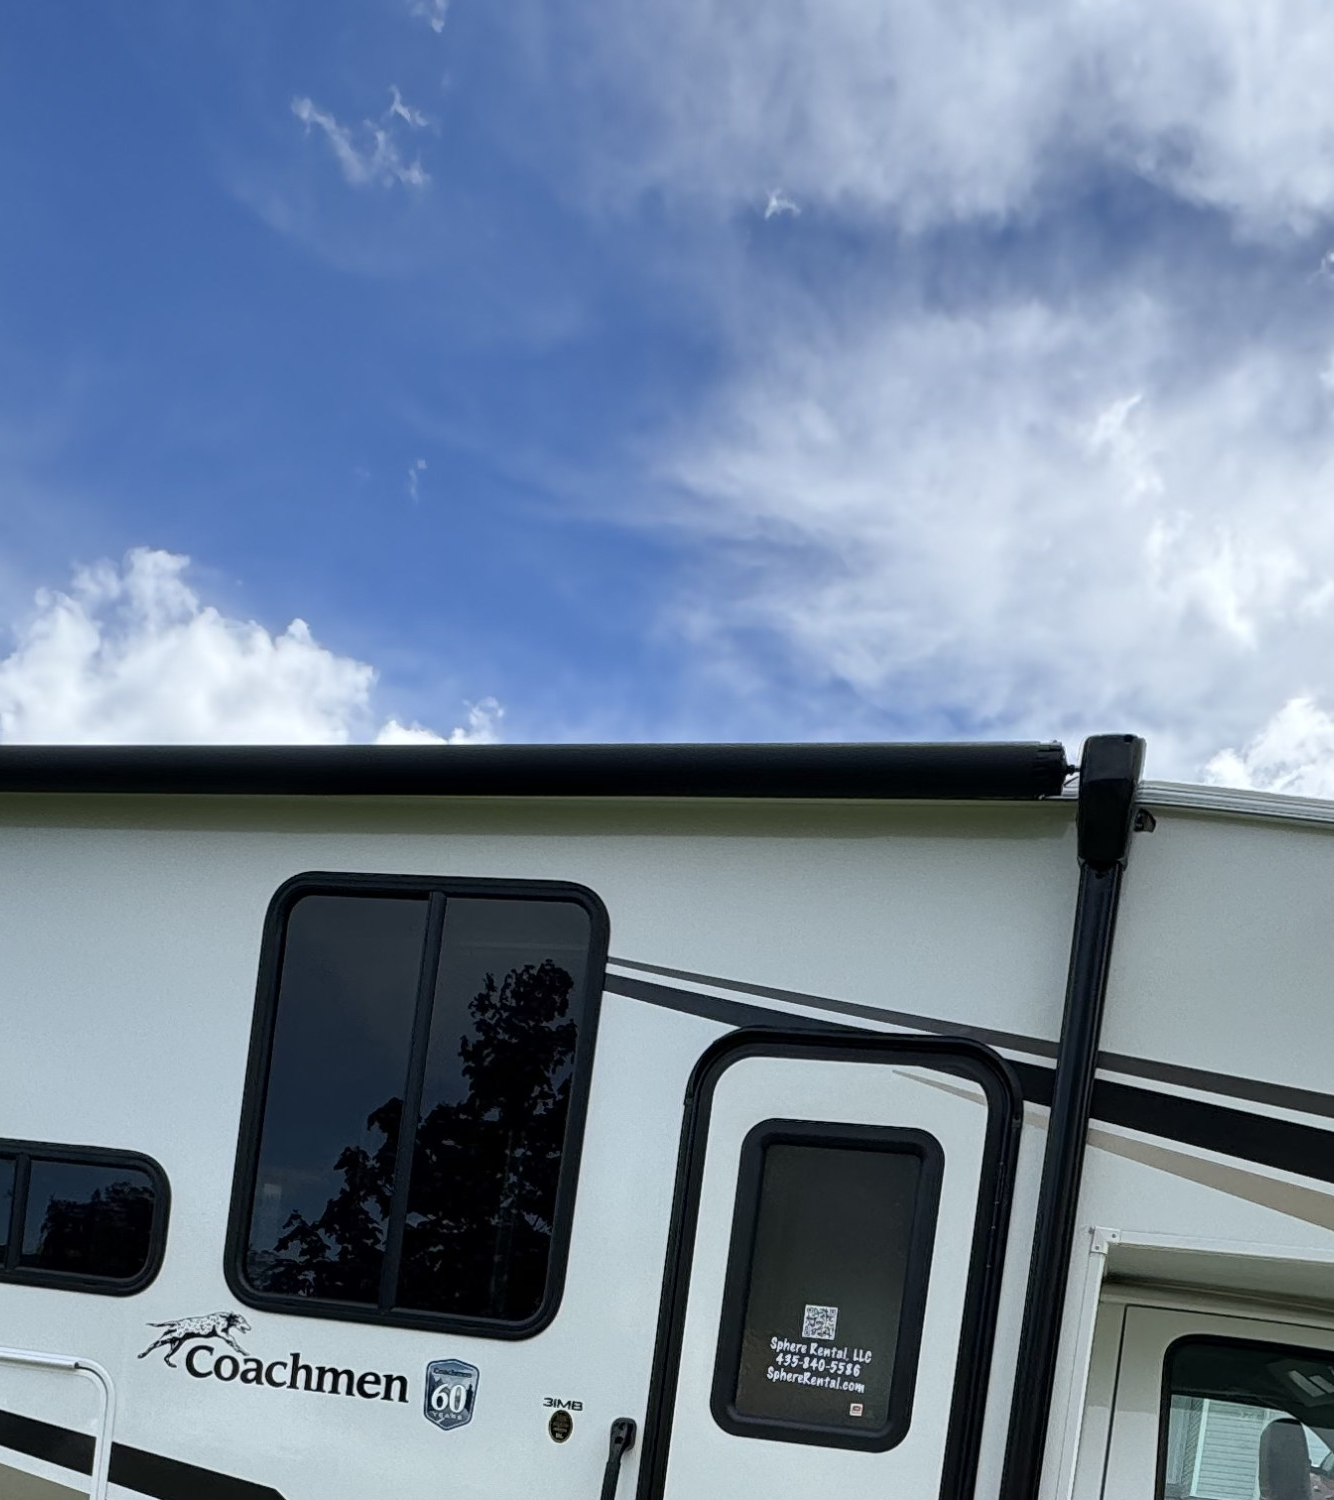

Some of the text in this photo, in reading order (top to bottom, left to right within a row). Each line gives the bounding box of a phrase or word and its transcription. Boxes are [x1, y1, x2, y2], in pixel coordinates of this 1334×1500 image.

[770, 1336, 807, 1354] Sphere
[853, 1349, 872, 1364] LLC
[185, 1345, 409, 1403] Coachmen
[775, 1353, 861, 1377] 435-840-5586
[766, 1366, 865, 1393] SphereRental.com
[430, 1384, 467, 1413] 60
